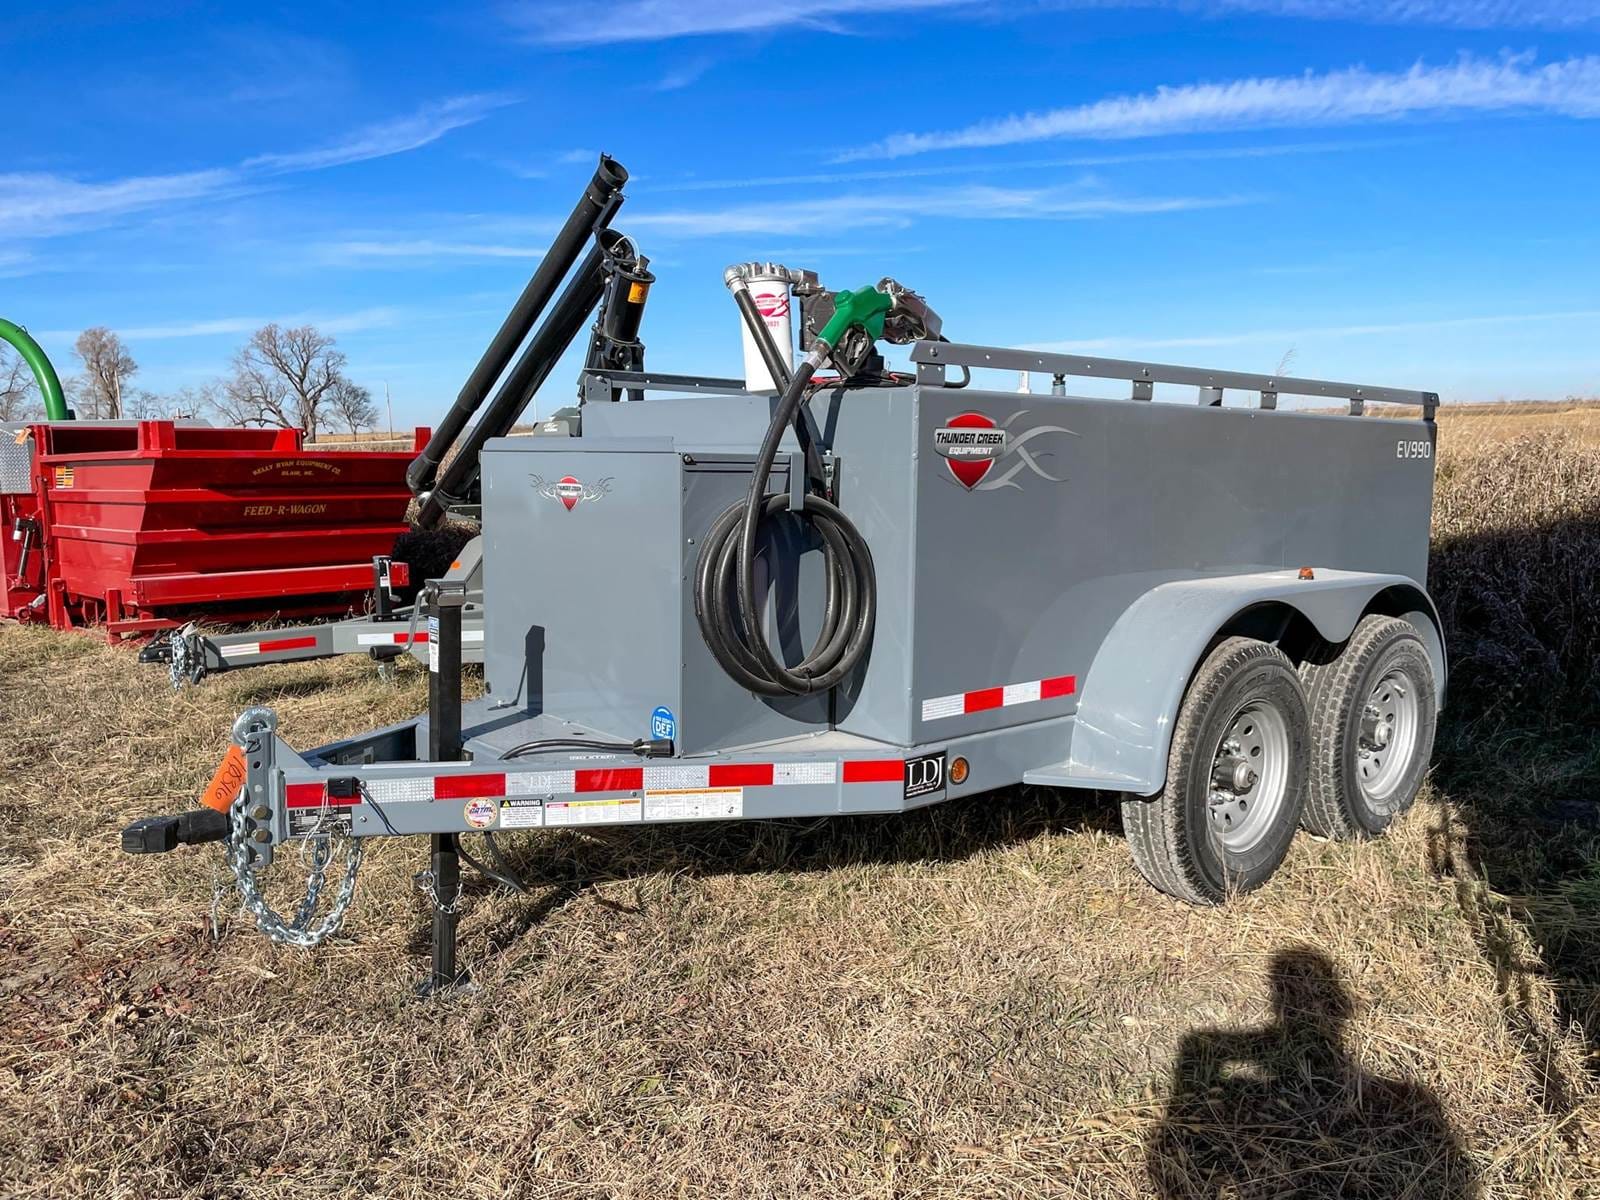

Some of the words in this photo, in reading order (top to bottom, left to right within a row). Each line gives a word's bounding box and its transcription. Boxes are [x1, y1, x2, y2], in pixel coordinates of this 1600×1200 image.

[936, 433, 975, 444] THUNDER
[977, 433, 1004, 445] CREEK
[948, 447, 993, 455] EQUIPMENT
[1396, 440, 1431, 459] EV990
[243, 504, 327, 516] FEED-R-WAGON
[655, 720, 672, 736] DEF
[907, 756, 946, 788] LDJ
